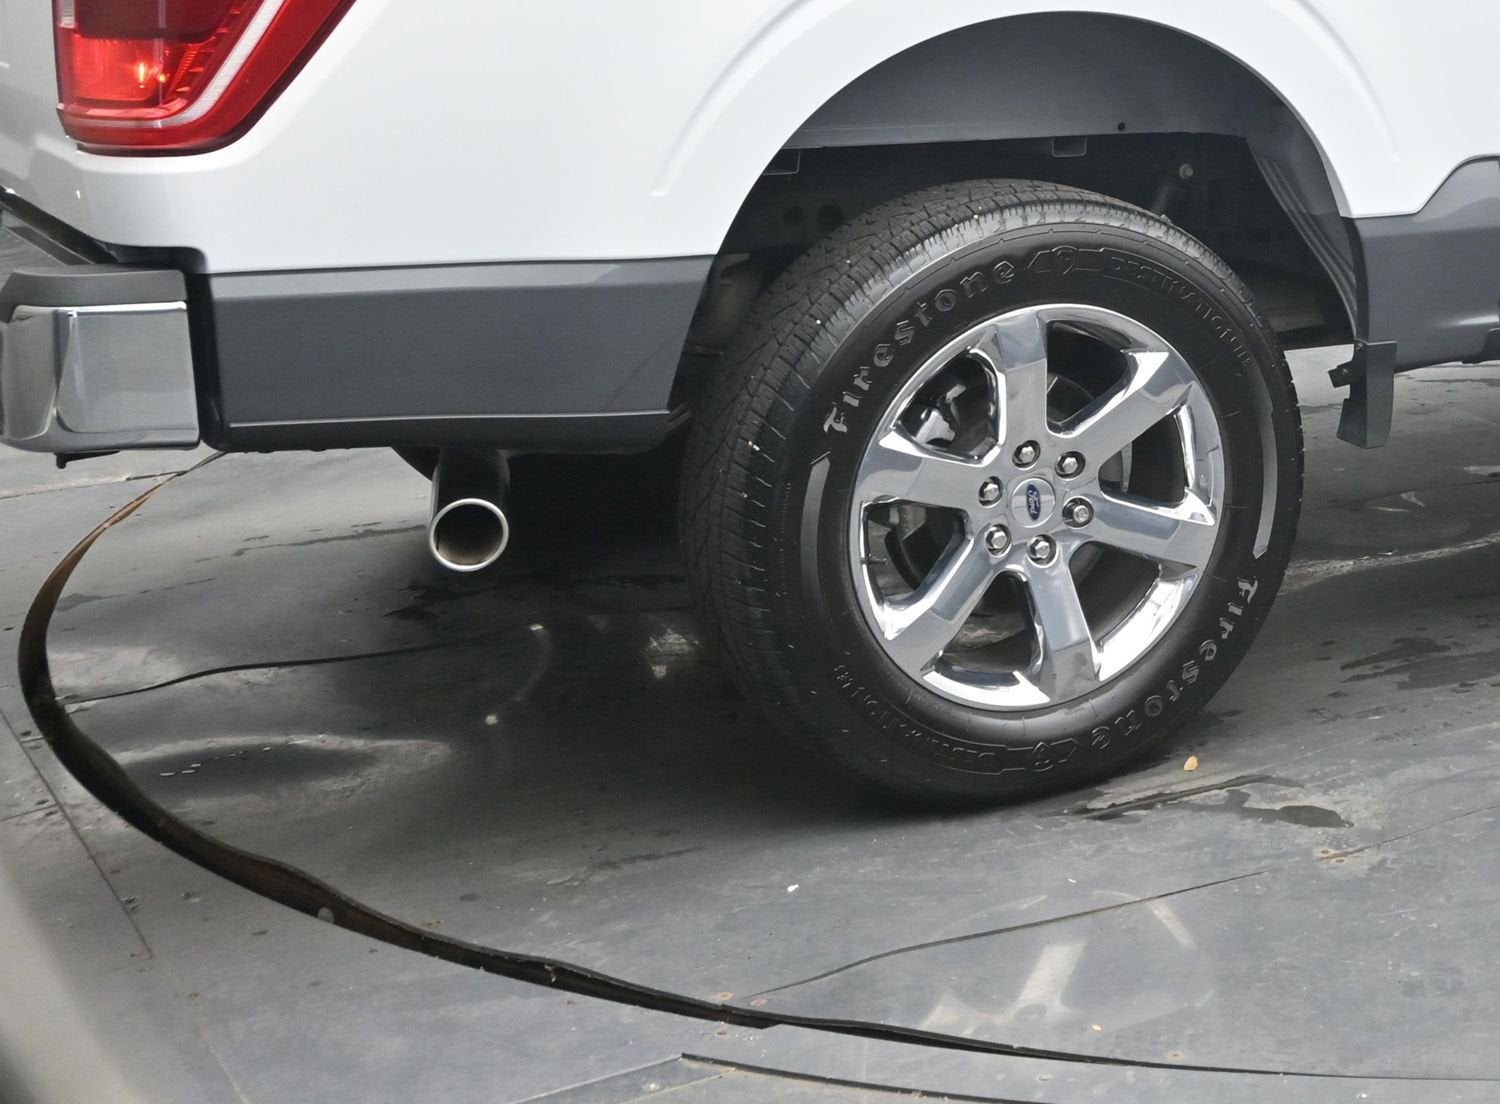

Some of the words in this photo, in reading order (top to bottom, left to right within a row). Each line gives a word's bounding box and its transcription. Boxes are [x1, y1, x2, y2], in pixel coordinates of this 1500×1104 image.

[823, 260, 1015, 433] Firestone
[1027, 489, 1039, 514] Ford
[1091, 576, 1259, 750] Firestone
